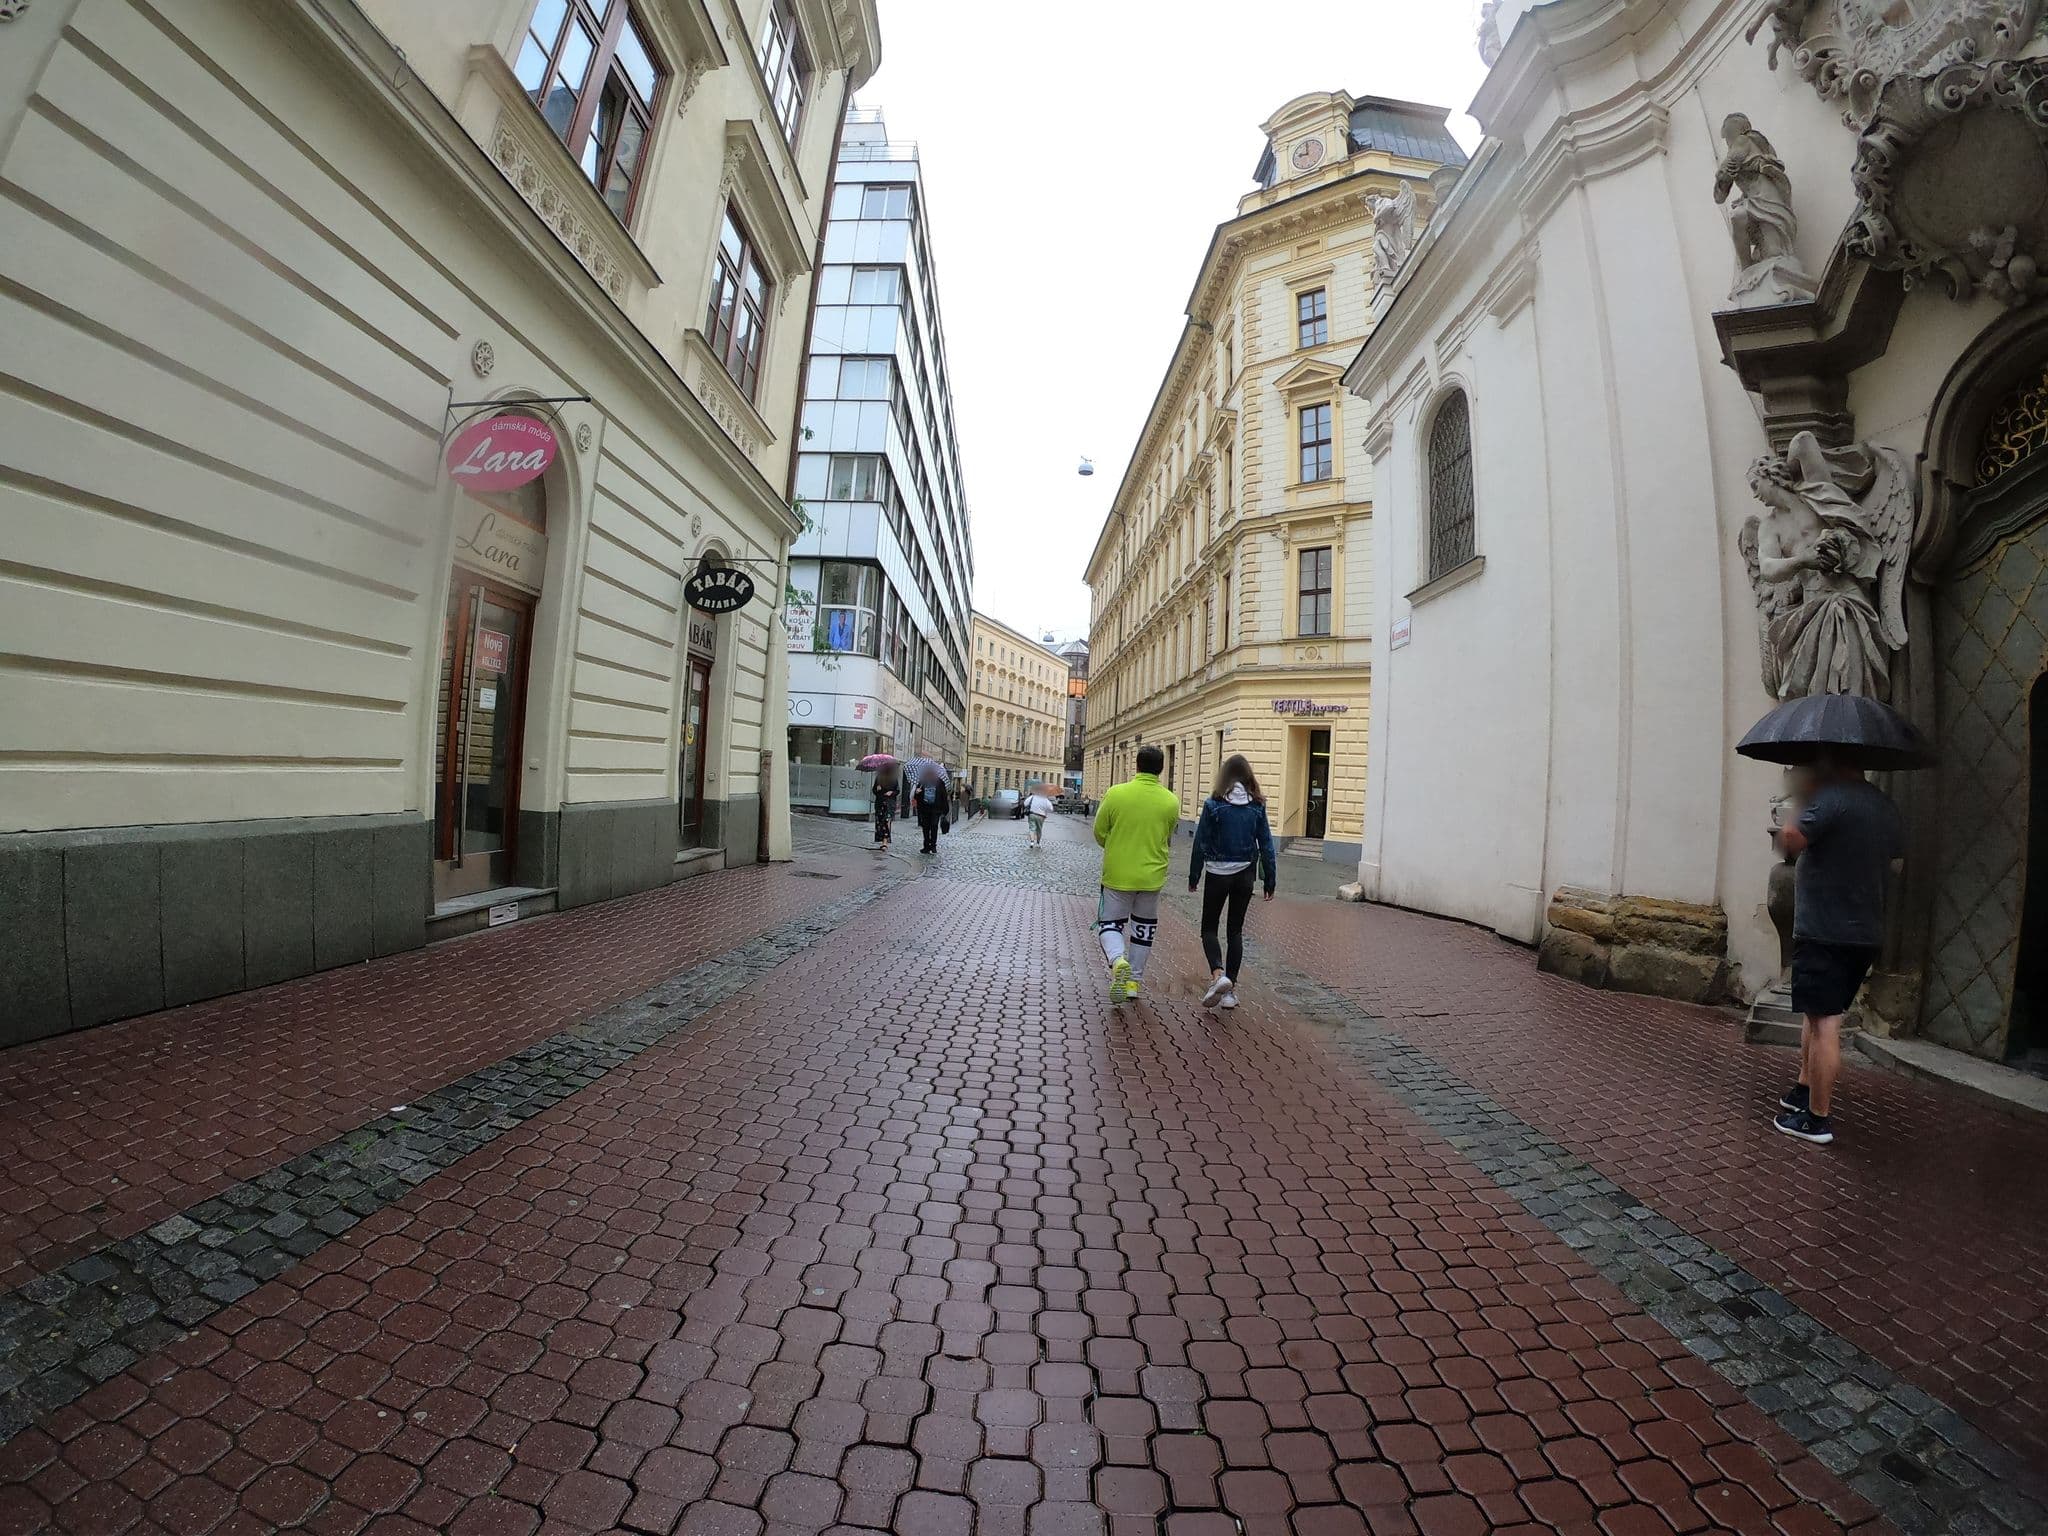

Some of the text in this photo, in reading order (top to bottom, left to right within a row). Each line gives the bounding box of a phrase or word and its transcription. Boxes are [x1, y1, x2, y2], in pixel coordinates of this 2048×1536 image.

[451, 437, 547, 474] Lara
[456, 513, 521, 571] Lara
[692, 572, 750, 595] TABÁK
[697, 597, 737, 609] ARIANA
